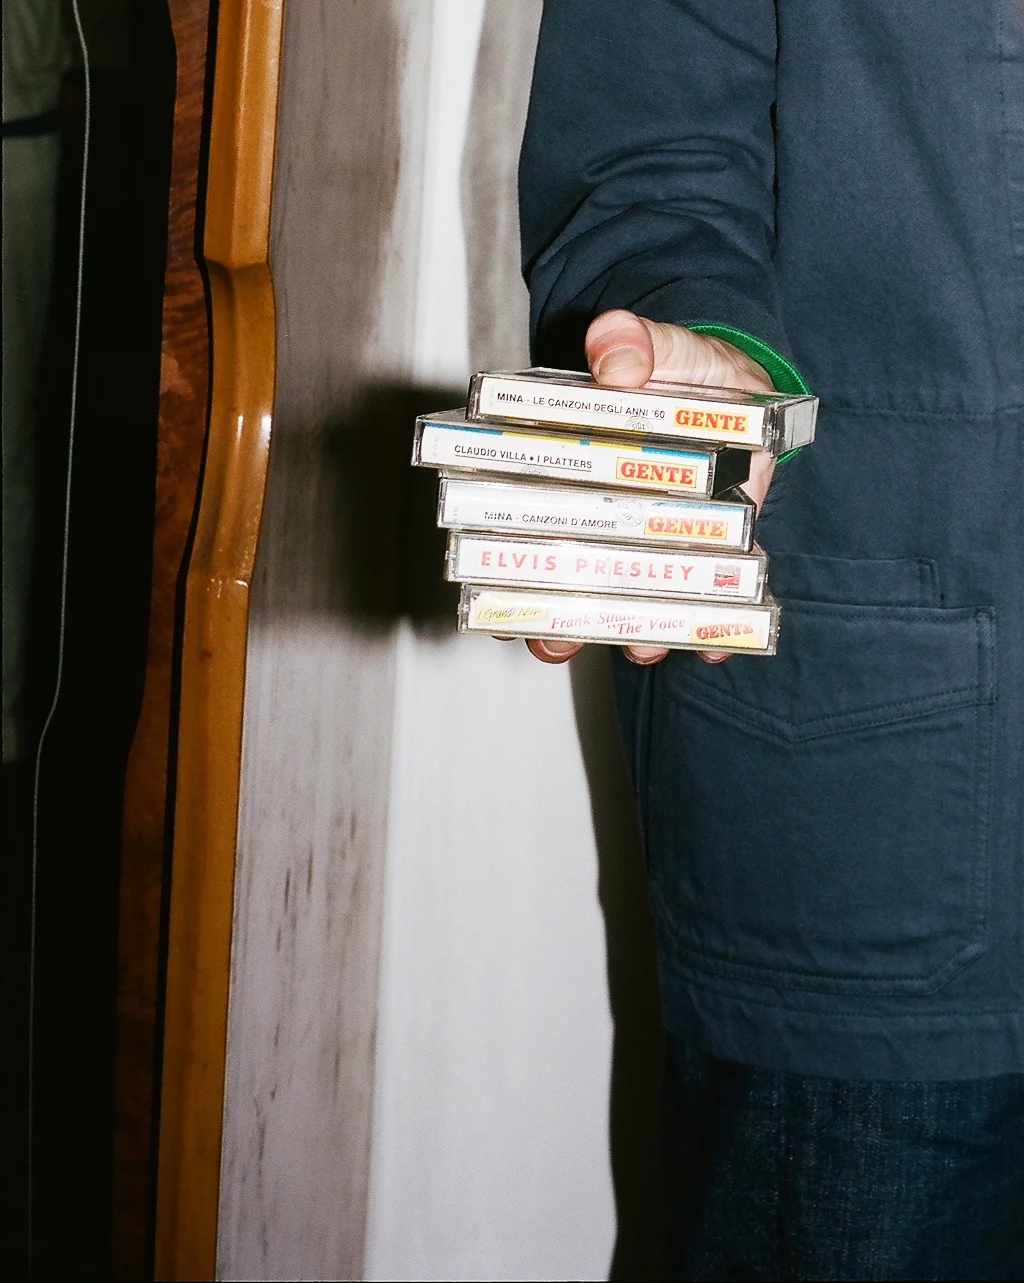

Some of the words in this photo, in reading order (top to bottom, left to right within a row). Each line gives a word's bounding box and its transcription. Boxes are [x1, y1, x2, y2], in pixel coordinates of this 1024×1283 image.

[497, 392, 523, 403] MINA
[533, 397, 545, 406] LE
[548, 398, 591, 410] CANZONI
[594, 403, 623, 414] DEGLI
[625, 407, 649, 417] ANNI
[652, 409, 666, 419] '60
[675, 409, 747, 432] GENTE
[454, 444, 497, 458] CLAUDIO
[499, 450, 526, 461] VILLA
[537, 455, 540, 463] I
[543, 455, 593, 469] PLATTERS
[621, 461, 694, 485] GENTE
[484, 511, 513, 522] MINA
[522, 514, 568, 526] CANZONI
[571, 518, 618, 529] D'AMORE
[648, 516, 724, 537] GENTE
[481, 550, 557, 571] ELVIS
[575, 557, 695, 581] PRESLEY
[550, 613, 591, 630] Frank
[648, 618, 686, 631] Voice
[696, 622, 754, 641] GENTE
